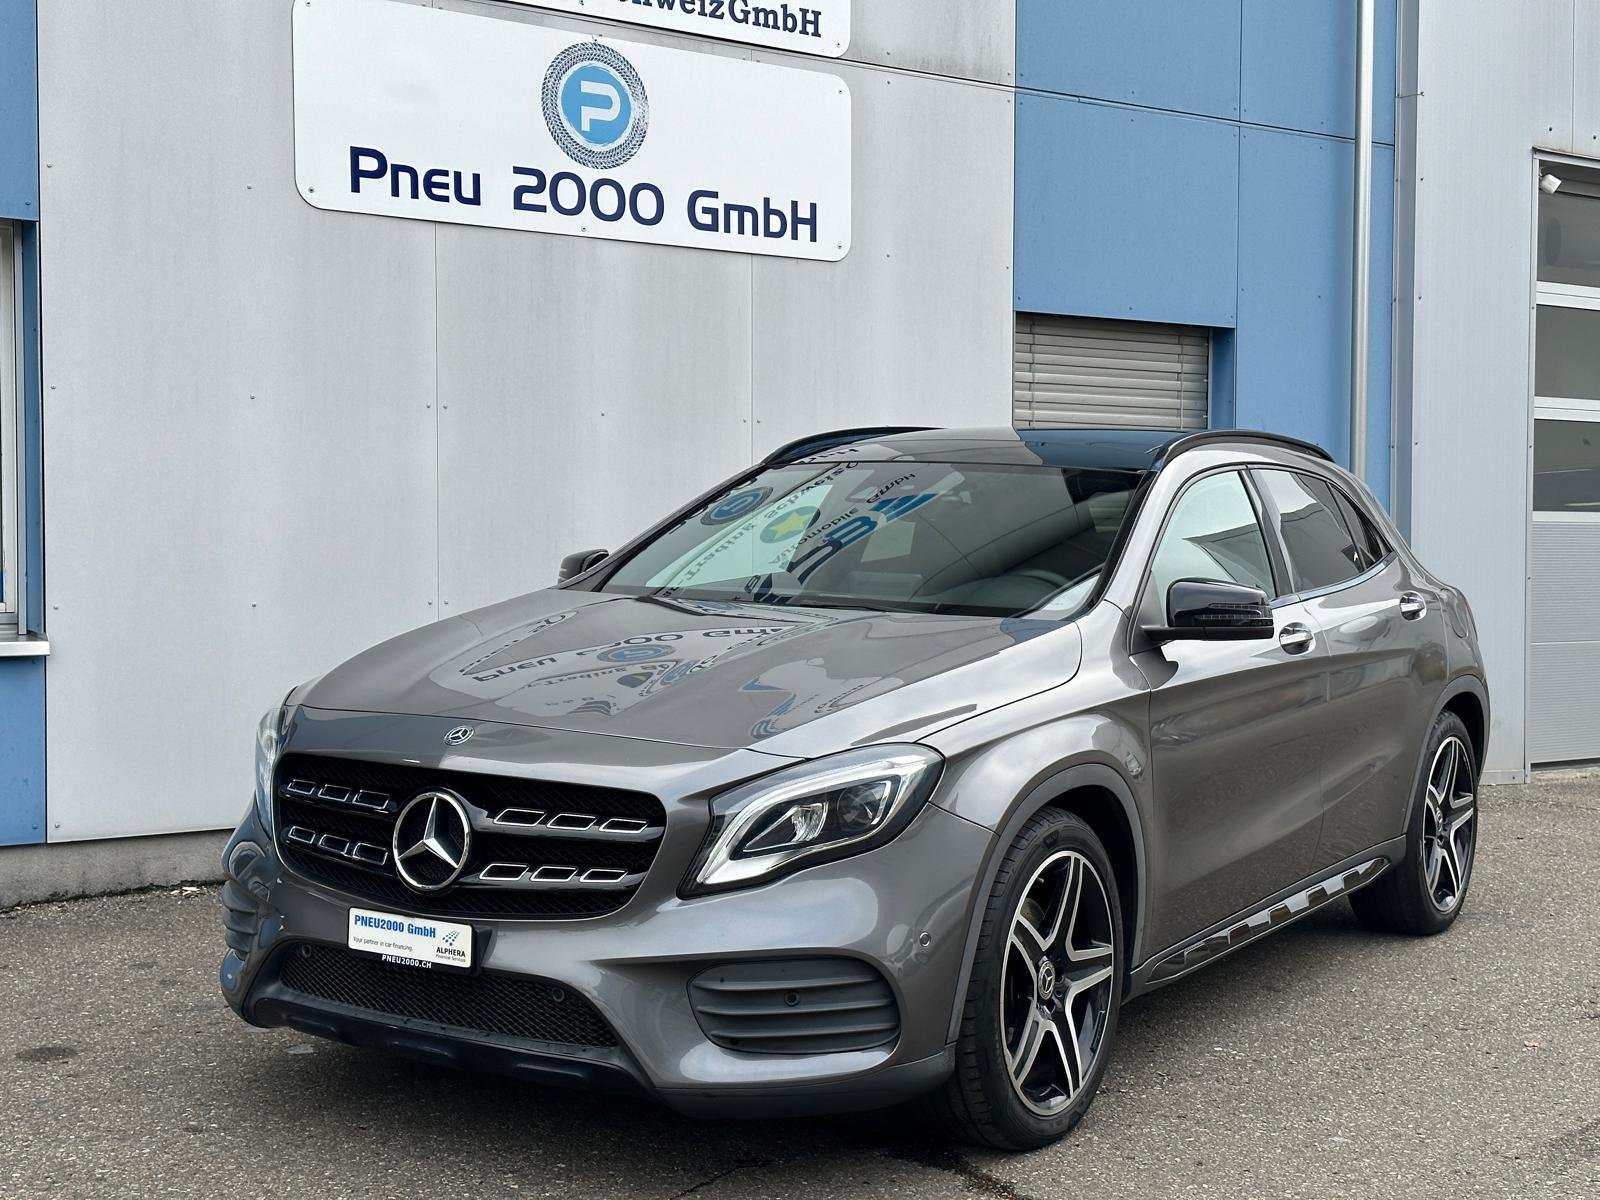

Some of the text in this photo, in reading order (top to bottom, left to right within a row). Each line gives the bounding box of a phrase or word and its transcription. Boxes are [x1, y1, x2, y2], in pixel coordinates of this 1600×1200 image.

[349, 145, 818, 243] Pneu 2000 GmbH
[354, 914, 437, 938] PNEU2000 GmbH
[353, 936, 363, 945] Your
[363, 938, 379, 947] partner
[436, 946, 466, 958] ALPHERA
[381, 954, 432, 969] PNEU2000.CH
